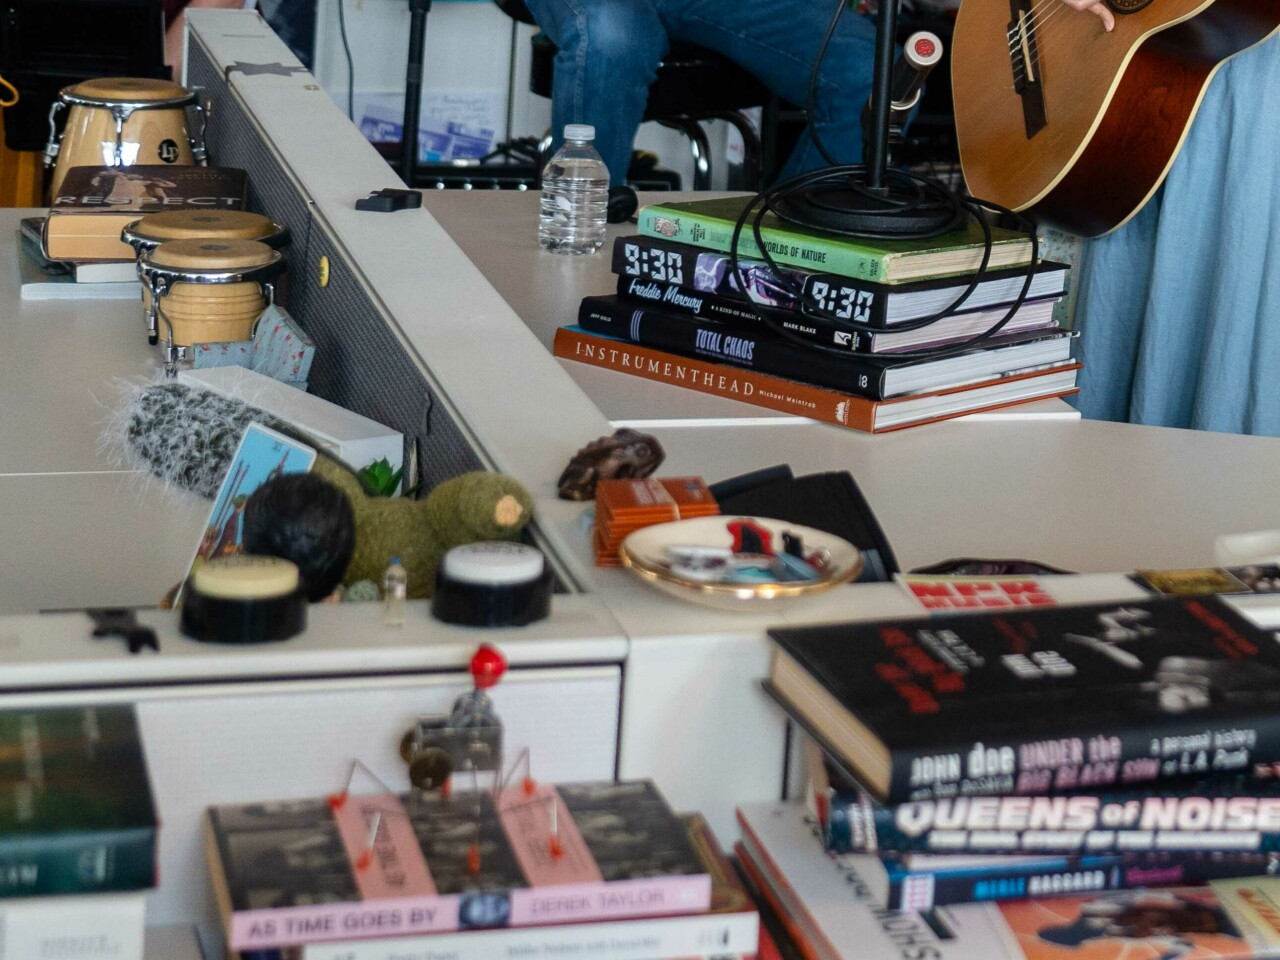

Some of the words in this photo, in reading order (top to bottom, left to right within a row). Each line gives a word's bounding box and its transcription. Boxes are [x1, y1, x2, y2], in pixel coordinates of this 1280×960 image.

[55, 195, 243, 207] RESPECT
[624, 243, 684, 285] 9:30
[763, 241, 789, 257] WORLDS
[790, 244, 800, 256] OF
[801, 248, 827, 264] NATURE
[628, 278, 662, 301] Freddie
[662, 289, 704, 314] Mercury
[811, 281, 874, 323] 9:30
[590, 312, 600, 320] JEFF
[600, 314, 612, 322] GOLD
[720, 306, 732, 315] KIND
[740, 310, 757, 320] MAGIC
[783, 321, 799, 330] MARK
[799, 325, 817, 334] BLAKE
[695, 328, 721, 353] TOTAL
[723, 335, 755, 360] CHAOS
[575, 341, 754, 396] INSTRUMENTHEAD
[759, 389, 784, 401] Michael
[786, 395, 817, 408] Weintrob
[910, 753, 961, 786] JOHN
[967, 743, 1015, 780] doe
[1019, 737, 1084, 770] UNDER
[1088, 734, 1122, 764] the
[1055, 760, 1118, 789] BLACK
[1122, 757, 1160, 783] SUN
[895, 795, 1100, 837] QUEENS
[1101, 800, 1141, 827] of
[531, 896, 592, 914] DEREK
[599, 890, 665, 911] TAYLOR
[249, 923, 278, 939] AS
[284, 917, 335, 935] TIME
[343, 911, 403, 930] GOES
[409, 908, 437, 925] BY
